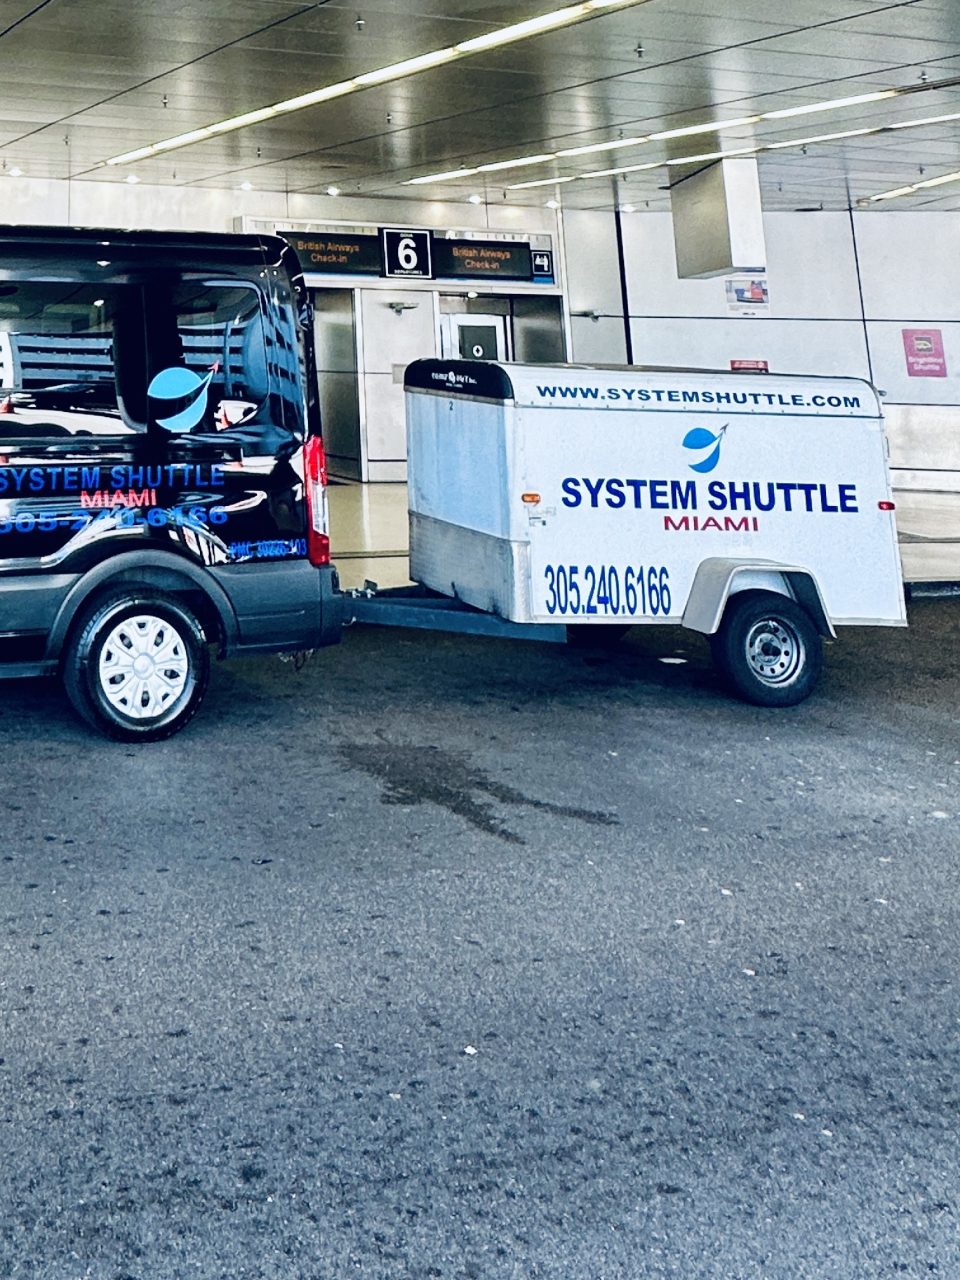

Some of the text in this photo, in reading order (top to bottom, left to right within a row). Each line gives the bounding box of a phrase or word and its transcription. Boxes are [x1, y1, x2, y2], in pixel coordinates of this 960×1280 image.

[297, 240, 360, 253] British Airways
[397, 238, 417, 270] 6
[452, 247, 511, 260] British Airways
[537, 385, 860, 408] WWW.SYSTEMSHUTTLE.COM
[110, 463, 225, 488] SHUTTLE
[80, 488, 157, 508] MIAMI
[561, 477, 859, 513] SYSTEM SHUTTLE
[663, 515, 759, 532] MIAMI
[544, 564, 672, 616] 305.240.6166
